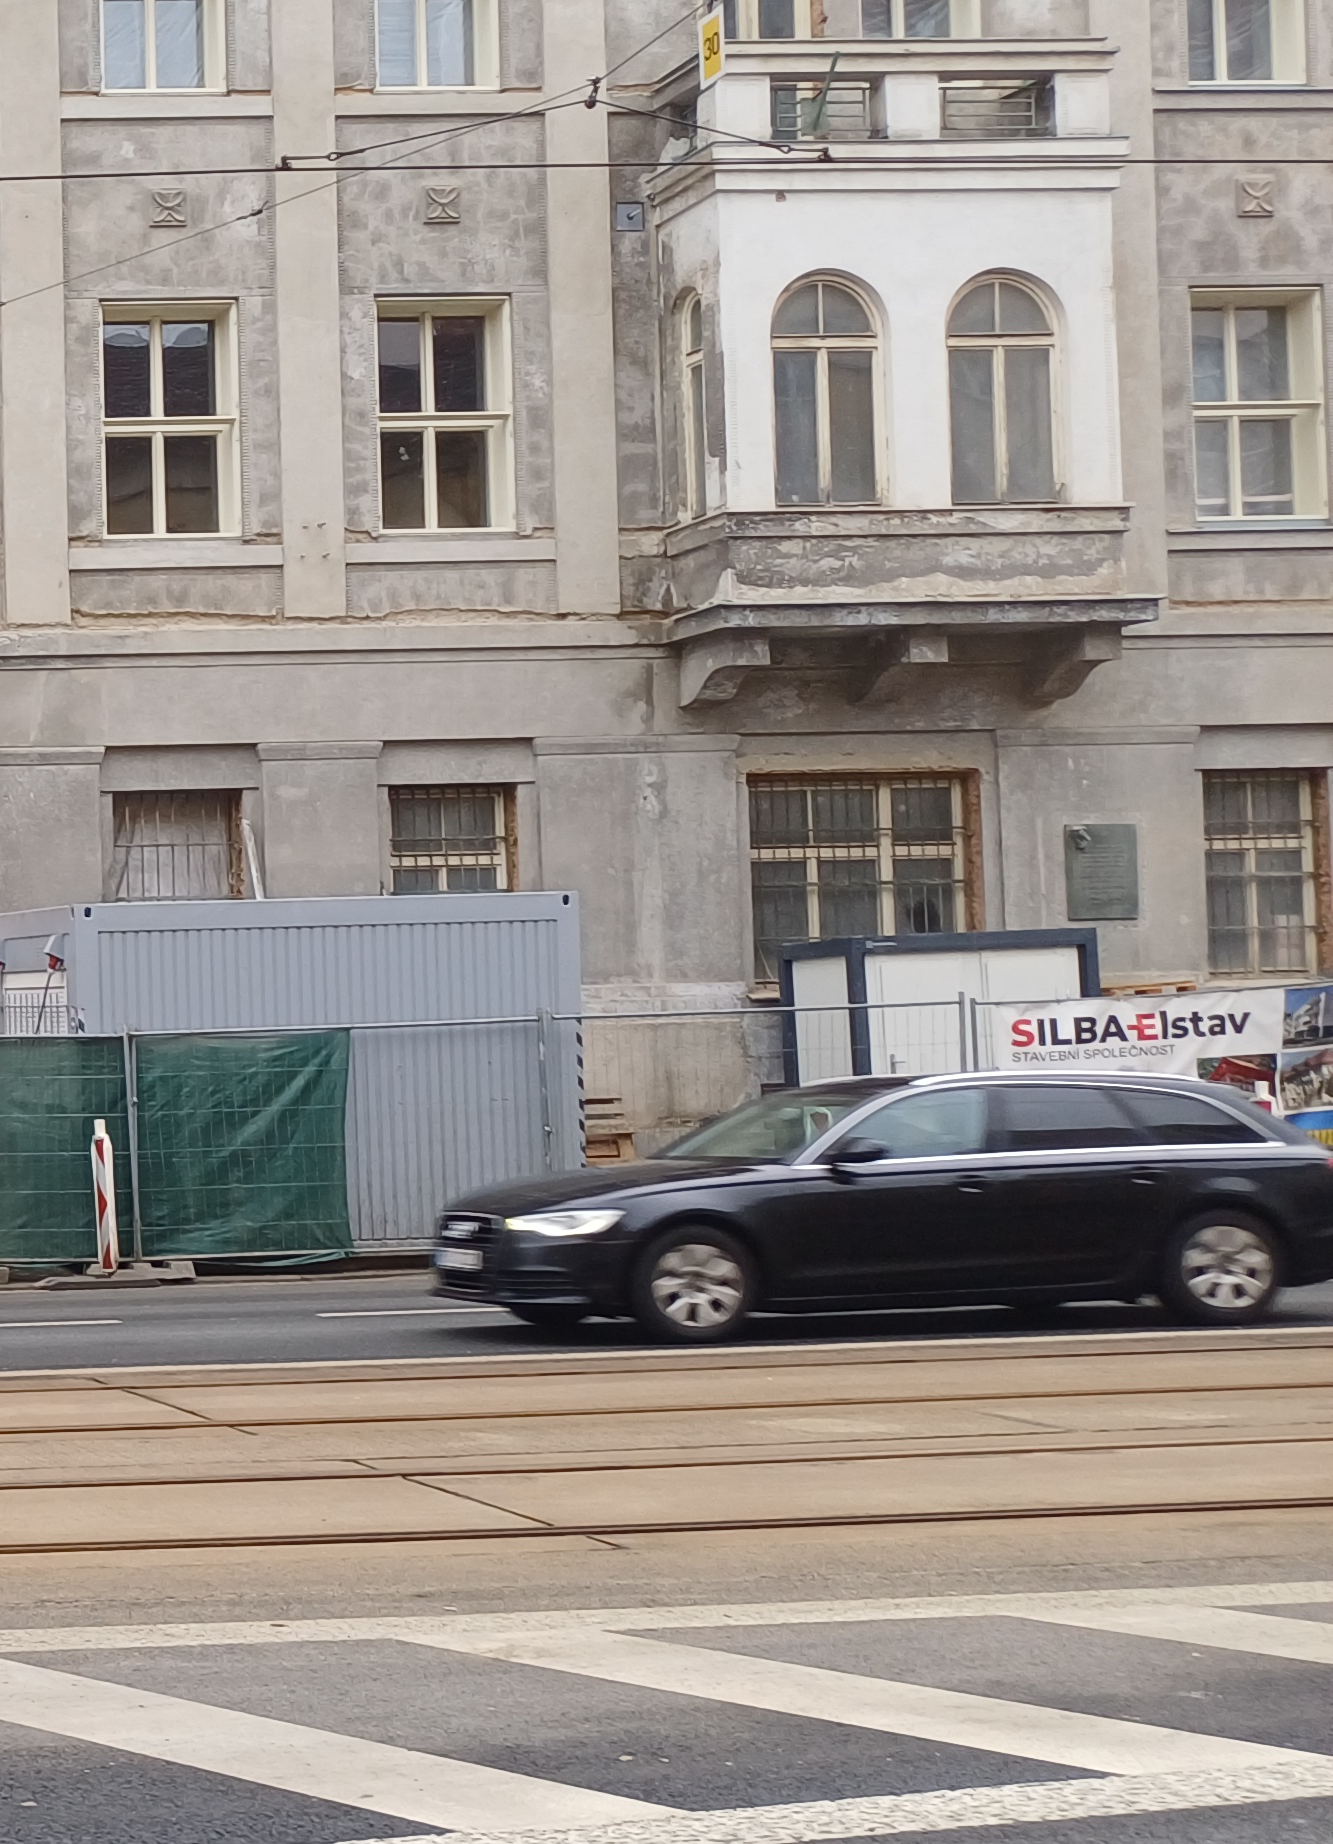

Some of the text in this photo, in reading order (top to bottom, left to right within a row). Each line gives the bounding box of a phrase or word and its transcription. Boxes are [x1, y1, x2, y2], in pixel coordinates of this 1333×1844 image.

[704, 31, 720, 61] 30
[1010, 1010, 1252, 1047] SILBA-Elstav
[1012, 1044, 1176, 1063] STAVEBNÍ SPOLEČNOST
